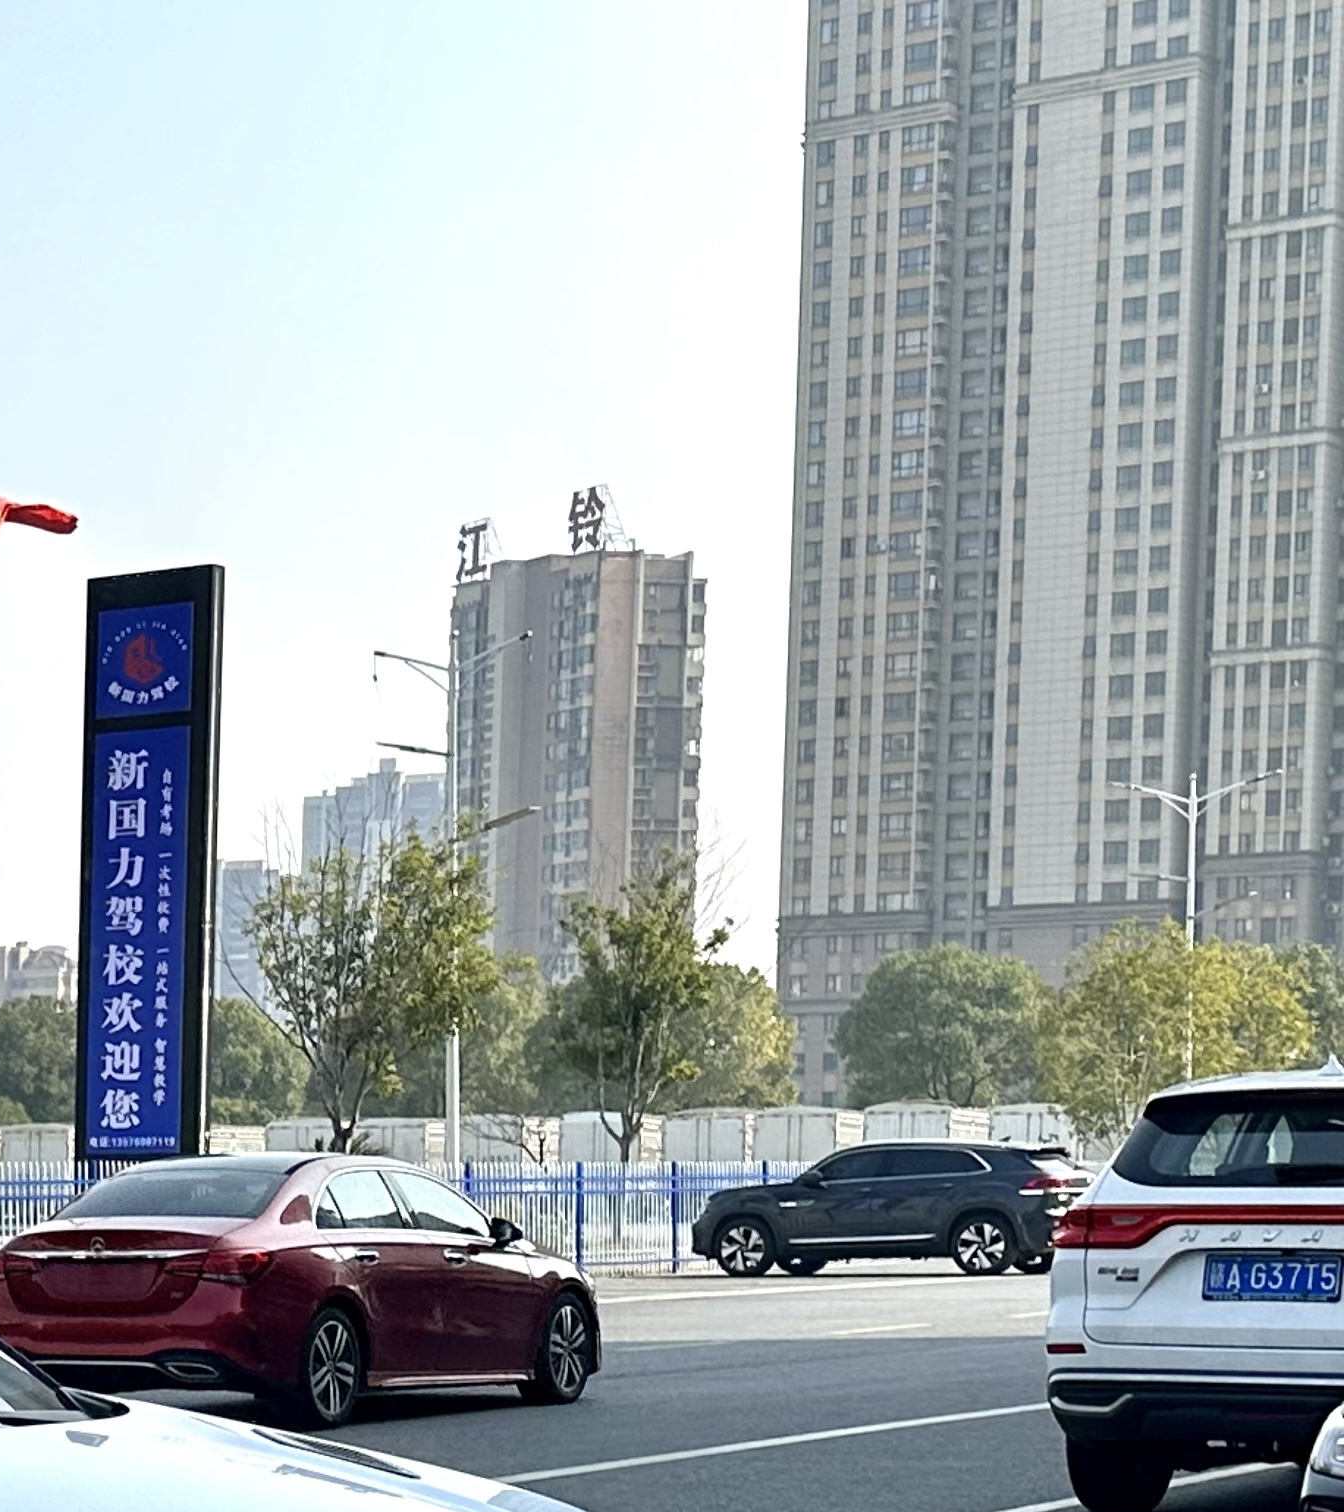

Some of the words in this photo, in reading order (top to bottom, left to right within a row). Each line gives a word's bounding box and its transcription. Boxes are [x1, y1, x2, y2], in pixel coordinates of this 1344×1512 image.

[456, 486, 605, 582] 江铃
[98, 749, 149, 1130] 新国力驾校欢迎您
